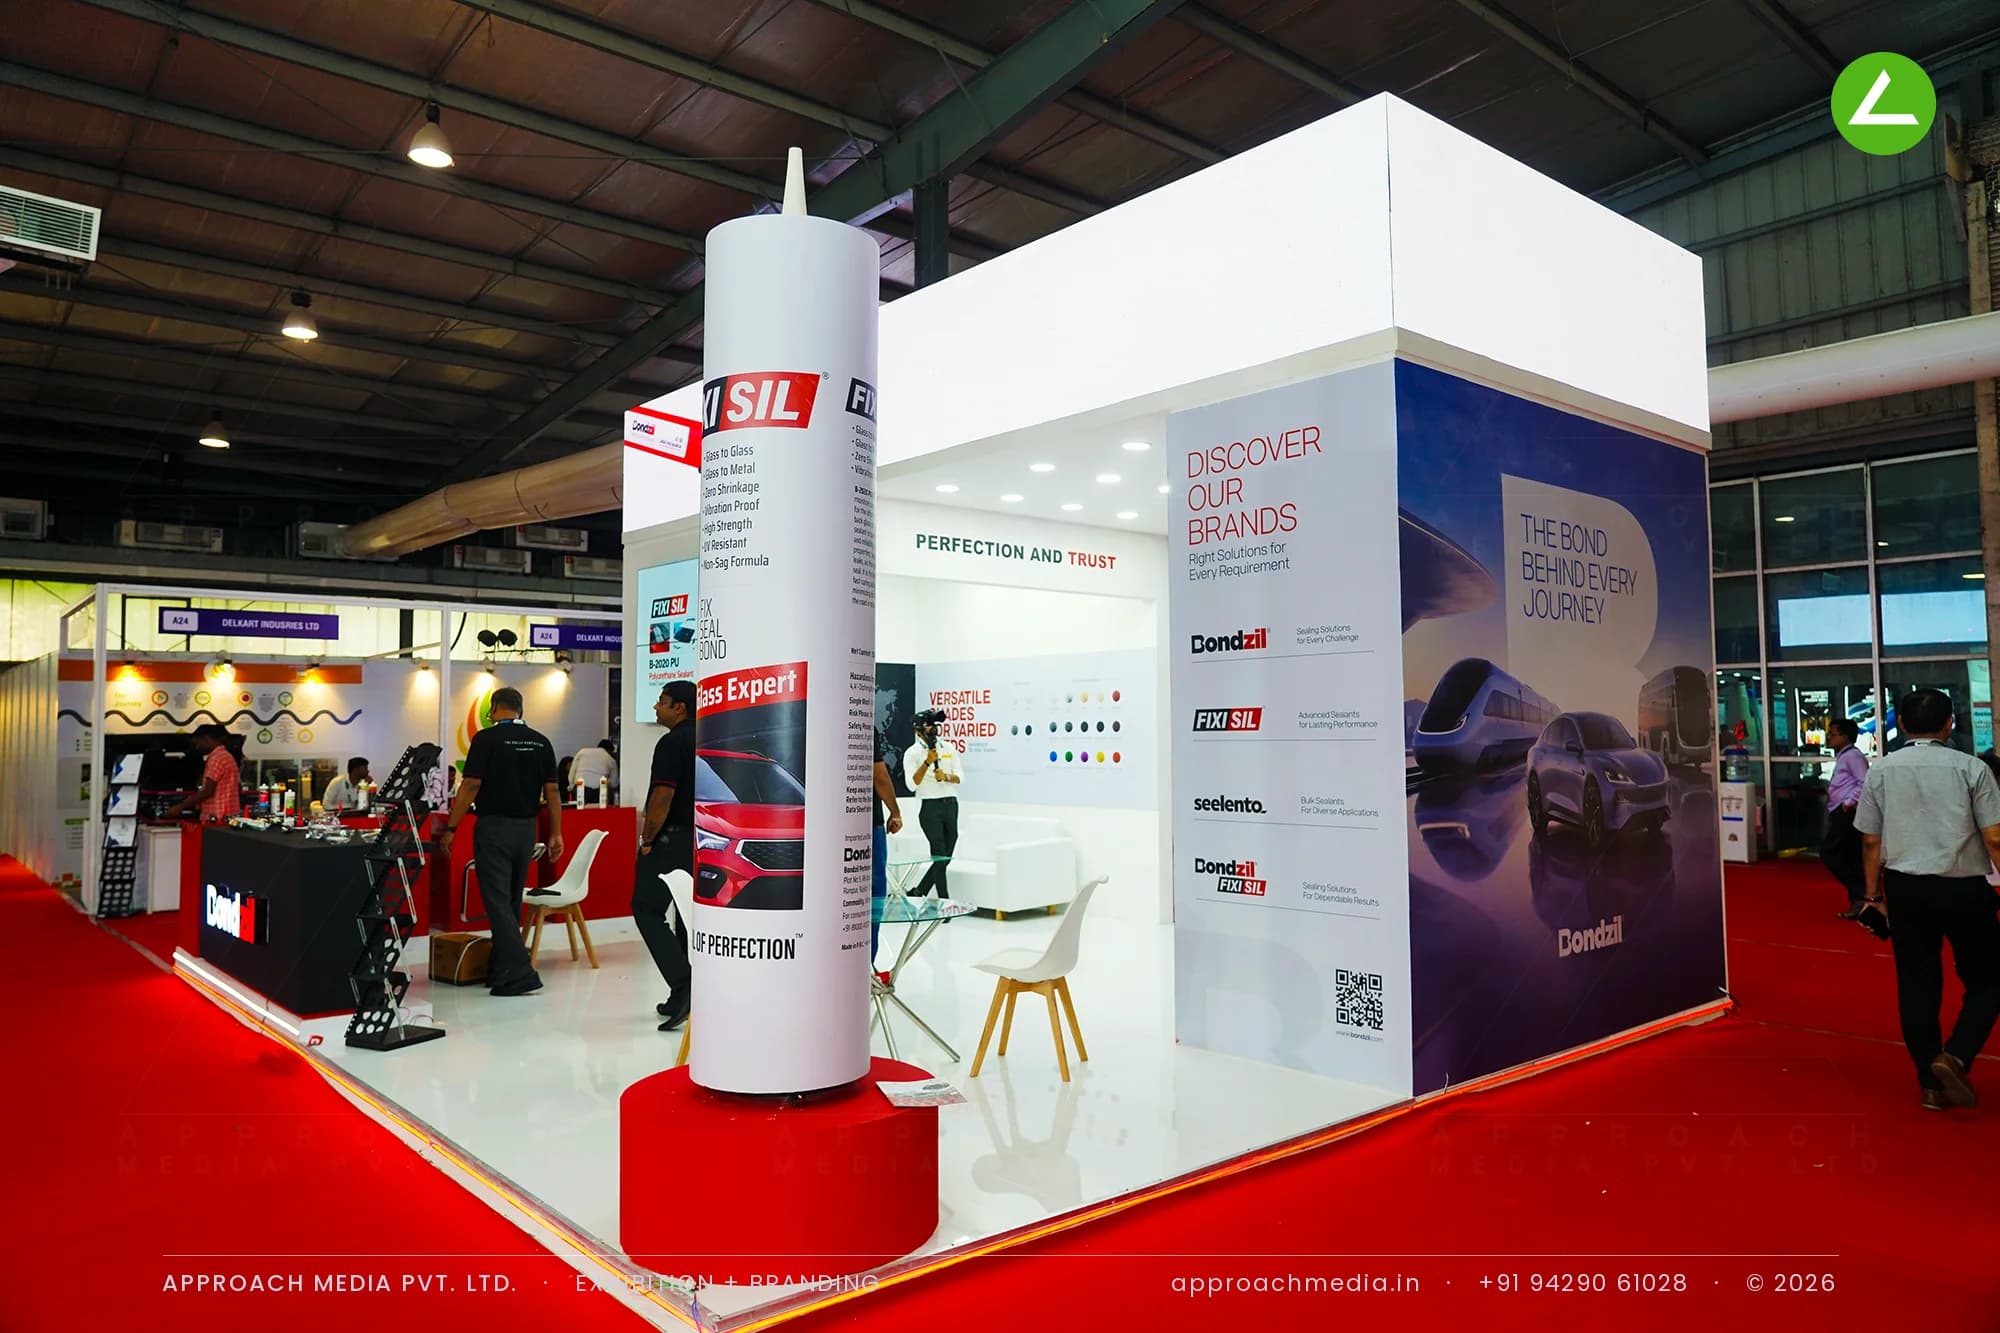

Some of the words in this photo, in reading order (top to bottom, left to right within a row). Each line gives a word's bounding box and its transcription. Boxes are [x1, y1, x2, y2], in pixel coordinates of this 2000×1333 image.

[726, 380, 800, 422] SIL
[851, 384, 877, 417] FIX
[705, 449, 719, 462] Glass
[720, 447, 729, 458] to
[730, 444, 754, 457] Glass
[1187, 426, 1322, 478] DISCOVER
[705, 468, 719, 480] Glass
[720, 466, 728, 477] to
[730, 461, 756, 475] Metal
[704, 486, 716, 498] Zero
[717, 480, 760, 496] Shrinkage
[1187, 477, 1243, 511] OUR
[734, 498, 760, 512] Proof
[717, 517, 753, 533] Strength
[1188, 503, 1298, 546] BRANDS
[711, 537, 747, 551] Resistant
[1520, 513, 1557, 549] THE
[1561, 522, 1608, 557] BOND
[916, 533, 1025, 560] PERFECTION
[1030, 547, 1063, 564] AND
[1068, 551, 1117, 570] TRUST
[1188, 551, 1216, 567] Right
[1217, 543, 1268, 562] Solutions
[1269, 541, 1287, 554] for
[703, 556, 729, 571] Non-Sag
[730, 554, 769, 568] Formula
[1189, 566, 1218, 581] Every
[1219, 557, 1290, 578] Requirement
[1522, 551, 1585, 588] BEHIND
[1588, 562, 1638, 597] EVERY
[653, 600, 670, 618] FIXI
[670, 596, 686, 614] SIL
[700, 597, 713, 618] FIX
[1523, 588, 1605, 625] JOURNEY
[172, 616, 189, 625] A24
[222, 618, 259, 628] DELKART
[305, 622, 320, 631] LTD
[699, 618, 723, 640] SEAL
[1296, 627, 1320, 636] Sealing
[1320, 624, 1351, 634] Solutions
[576, 633, 604, 642] DELKART
[1191, 627, 1267, 654] Bondzil
[1296, 637, 1305, 645] for
[1306, 636, 1325, 645] Every
[1325, 633, 1359, 644] Challenge
[699, 639, 727, 661] BOND
[649, 659, 670, 670] B-2020
[670, 657, 680, 668] PU
[649, 671, 677, 681] Polyurethane
[677, 670, 694, 679] Sealant
[726, 669, 798, 704] Expert
[929, 690, 991, 705] VERSATILE
[931, 706, 975, 721] ADES
[1196, 711, 1229, 729] FIXI
[1230, 711, 1257, 729] SIL
[1298, 710, 1330, 719] Advanced
[936, 723, 951, 737] OR
[952, 723, 997, 737] VARIED
[1298, 720, 1308, 729] for
[1308, 720, 1333, 730] Lasting
[1333, 720, 1378, 729] Performance
[1300, 795, 1314, 805] Bulk
[1300, 806, 1311, 814] For
[1312, 806, 1337, 815] Diverse
[1338, 807, 1379, 818] Applications
[844, 845, 872, 862] Bond
[1194, 857, 1255, 878] Bondzil
[1218, 878, 1243, 893] FIXI
[1244, 880, 1265, 895] SIL
[1302, 882, 1326, 893] Sealing
[1326, 884, 1358, 894] Solutions
[1303, 892, 1313, 900] For
[1314, 892, 1353, 904] Dependable
[1353, 896, 1380, 907] Results
[1558, 915, 1623, 958] Bondzil
[696, 931, 706, 952] OF
[707, 934, 797, 961] PERFECTION
